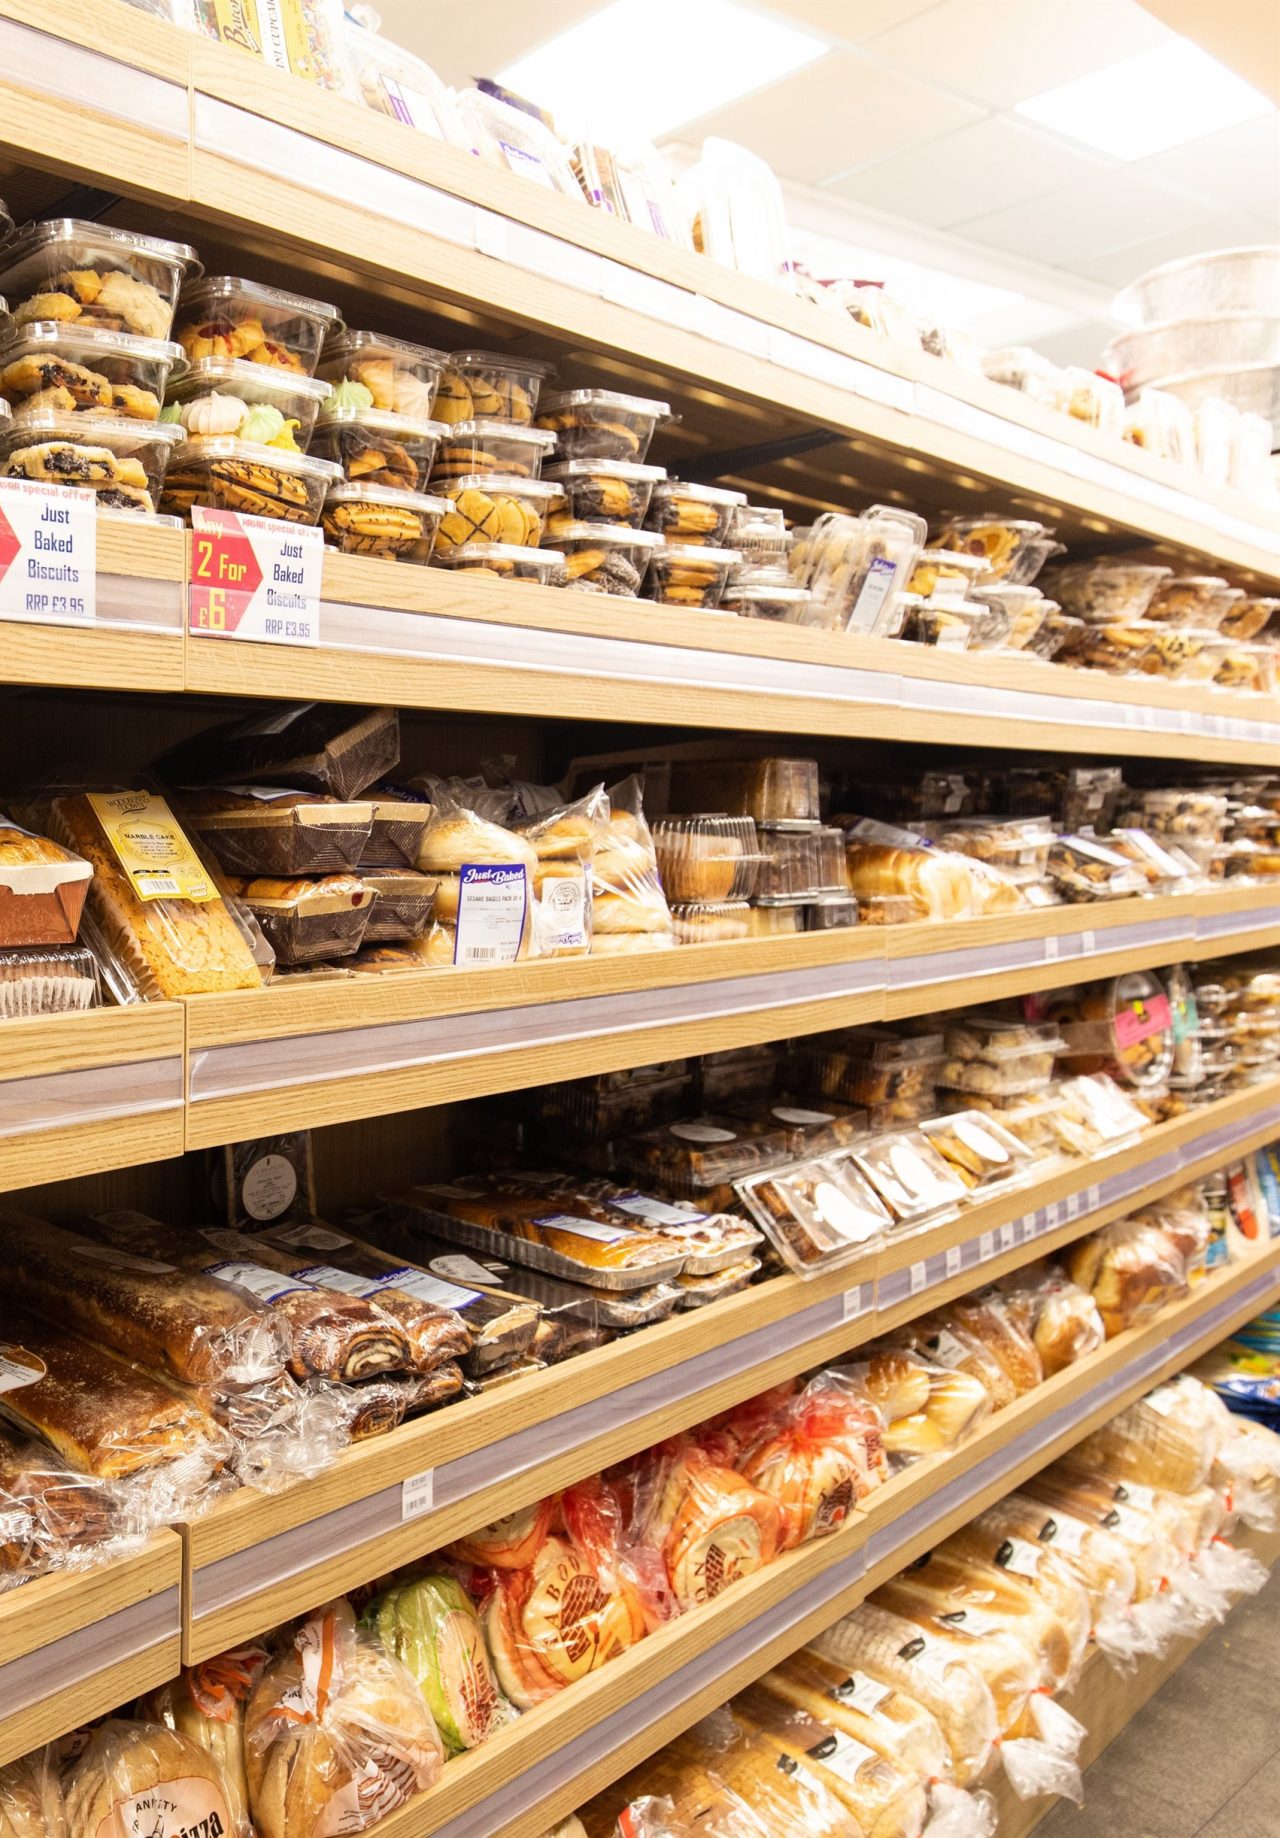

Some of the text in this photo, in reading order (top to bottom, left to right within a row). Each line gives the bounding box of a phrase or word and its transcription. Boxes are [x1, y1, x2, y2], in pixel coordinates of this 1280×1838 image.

[23, 485, 59, 499] special
[63, 489, 92, 502] offer
[41, 503, 70, 524] Just
[200, 512, 224, 540] Any
[268, 522, 295, 534] special
[34, 531, 73, 553] Baked
[280, 541, 304, 558] Just
[28, 559, 79, 583] Biscuits
[197, 540, 247, 582] 2 For
[273, 564, 304, 584] Baked
[26, 594, 84, 613] RRP £3.95
[199, 588, 225, 631] £6
[267, 589, 306, 610] Biscuits
[265, 619, 310, 638] RRP £3.95
[463, 868, 524, 885] Just Baked
